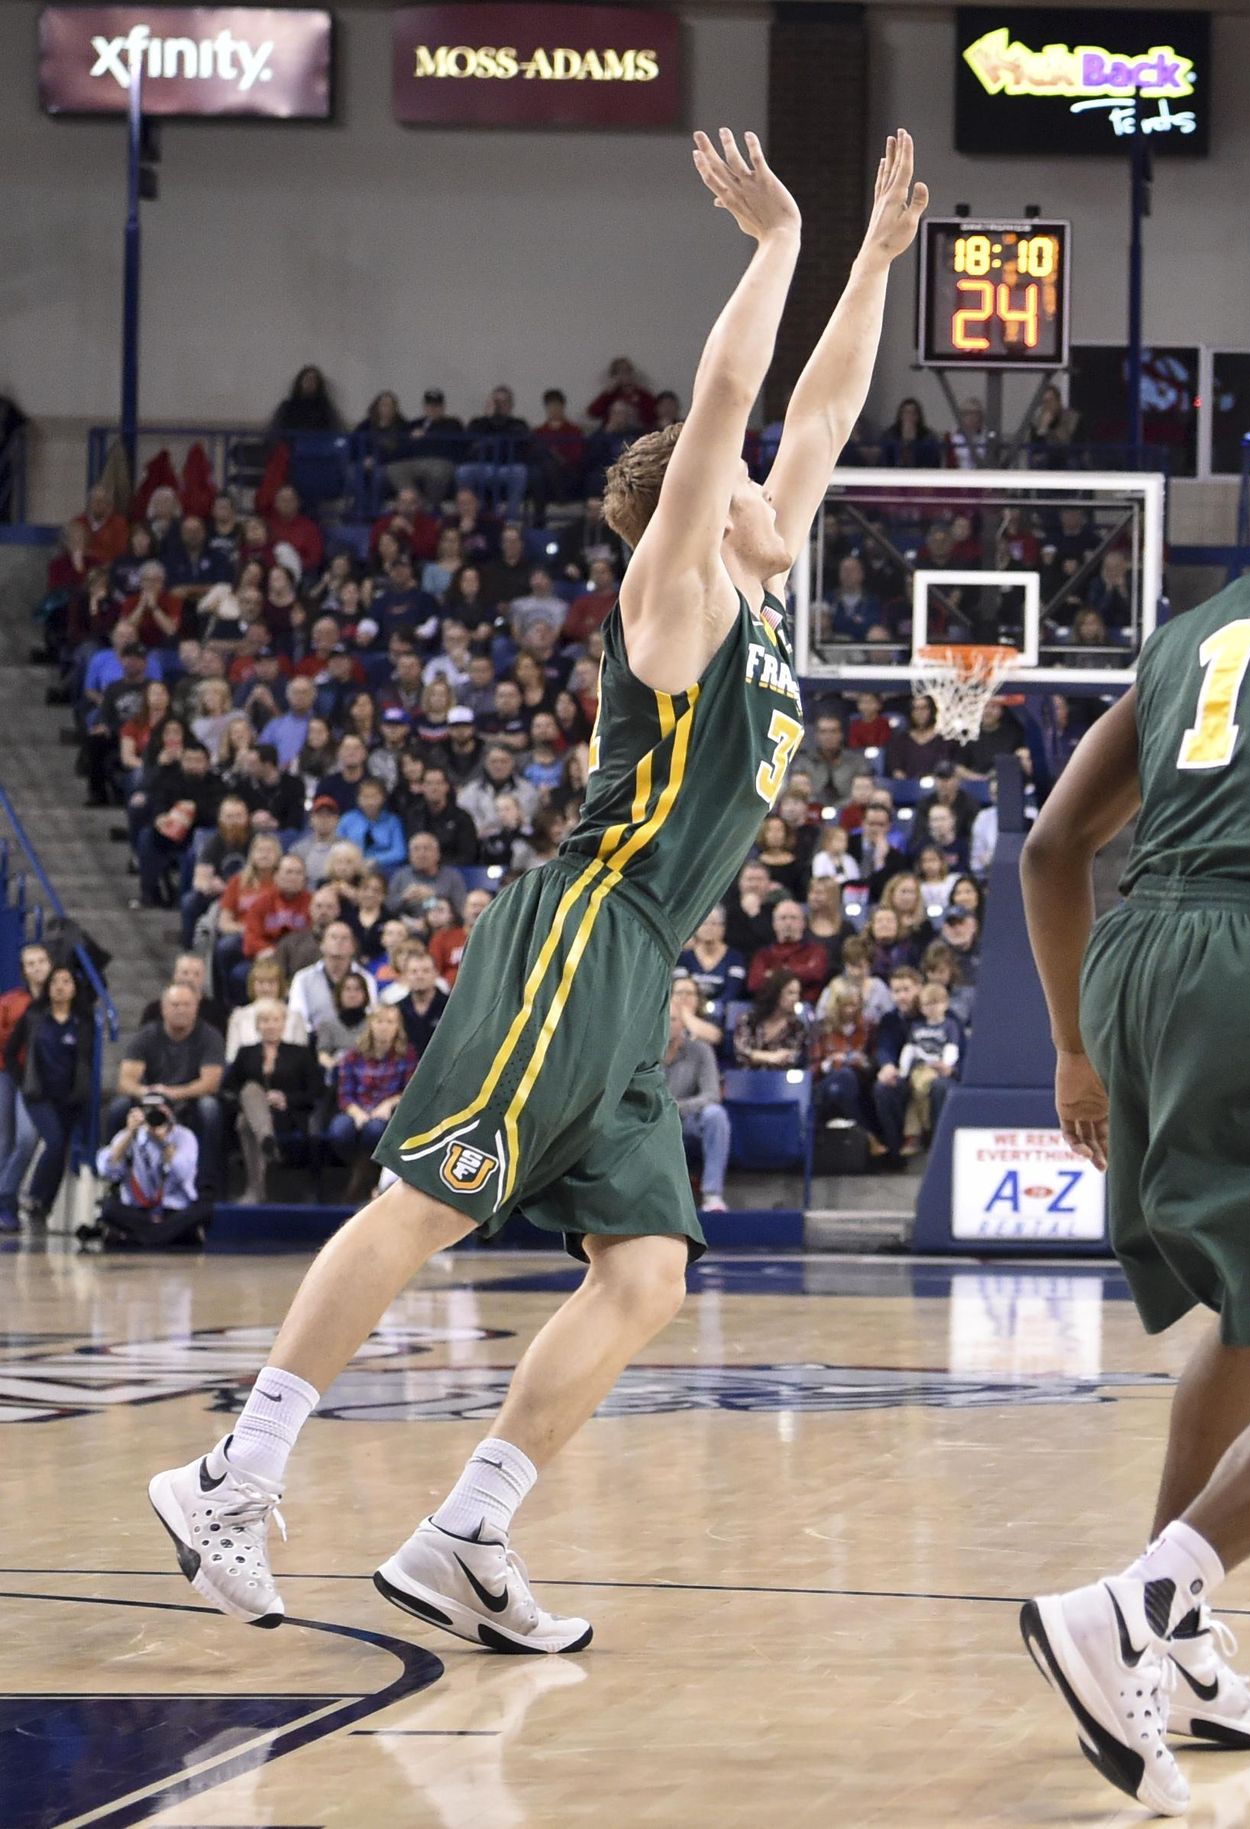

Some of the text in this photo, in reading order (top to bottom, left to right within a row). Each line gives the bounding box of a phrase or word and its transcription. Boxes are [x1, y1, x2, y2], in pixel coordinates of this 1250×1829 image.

[953, 234, 1054, 277] 18:10
[951, 279, 1039, 349] 24
[756, 708, 805, 811] 3
